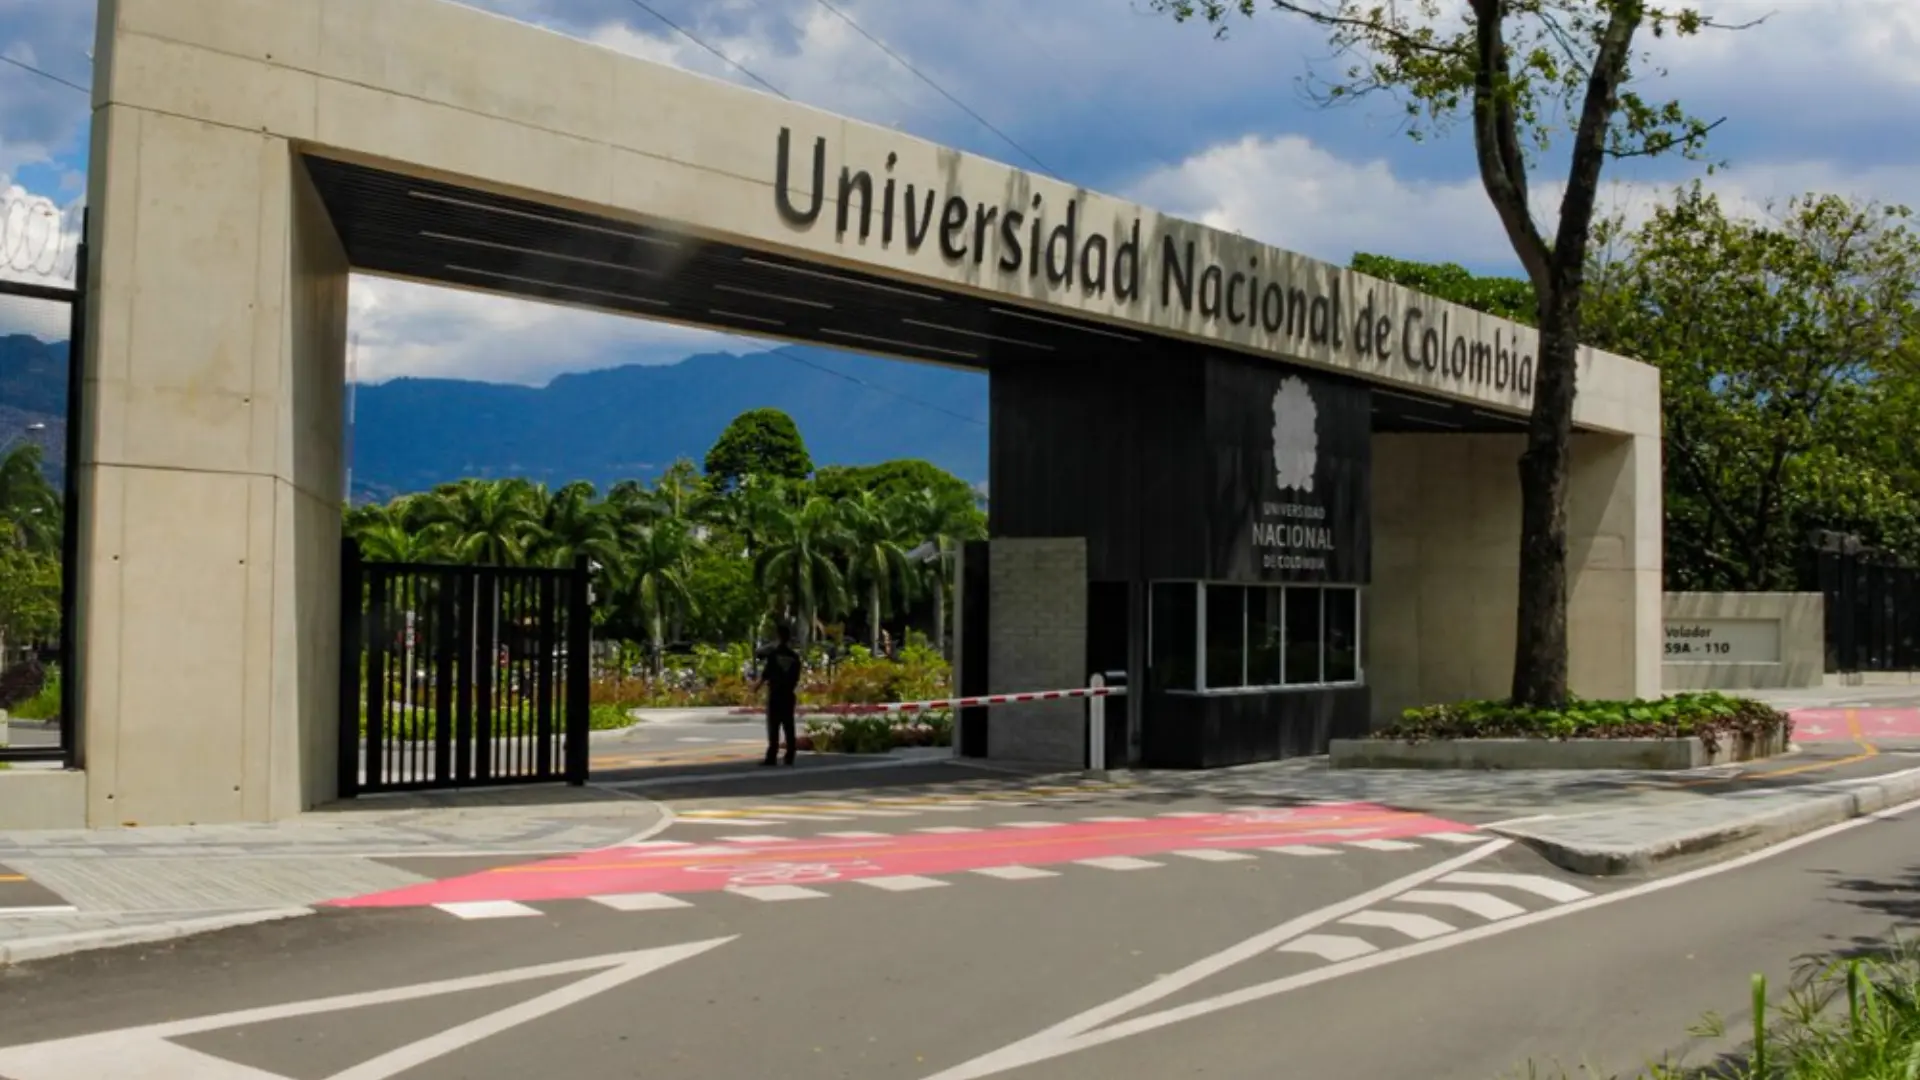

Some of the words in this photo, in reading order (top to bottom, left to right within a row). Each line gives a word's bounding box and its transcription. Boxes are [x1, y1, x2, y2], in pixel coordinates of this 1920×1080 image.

[774, 127, 1141, 301] Universidad
[1162, 234, 1342, 350] Nacional
[1355, 291, 1391, 360] de
[1402, 306, 1533, 396] Colombia
[1263, 502, 1325, 519] UNIVERSIDAD
[1252, 522, 1335, 550] NACIONAL
[1263, 554, 1276, 568] DE
[1278, 555, 1325, 570] COLOMBIA
[1705, 642, 1730, 654] 110
